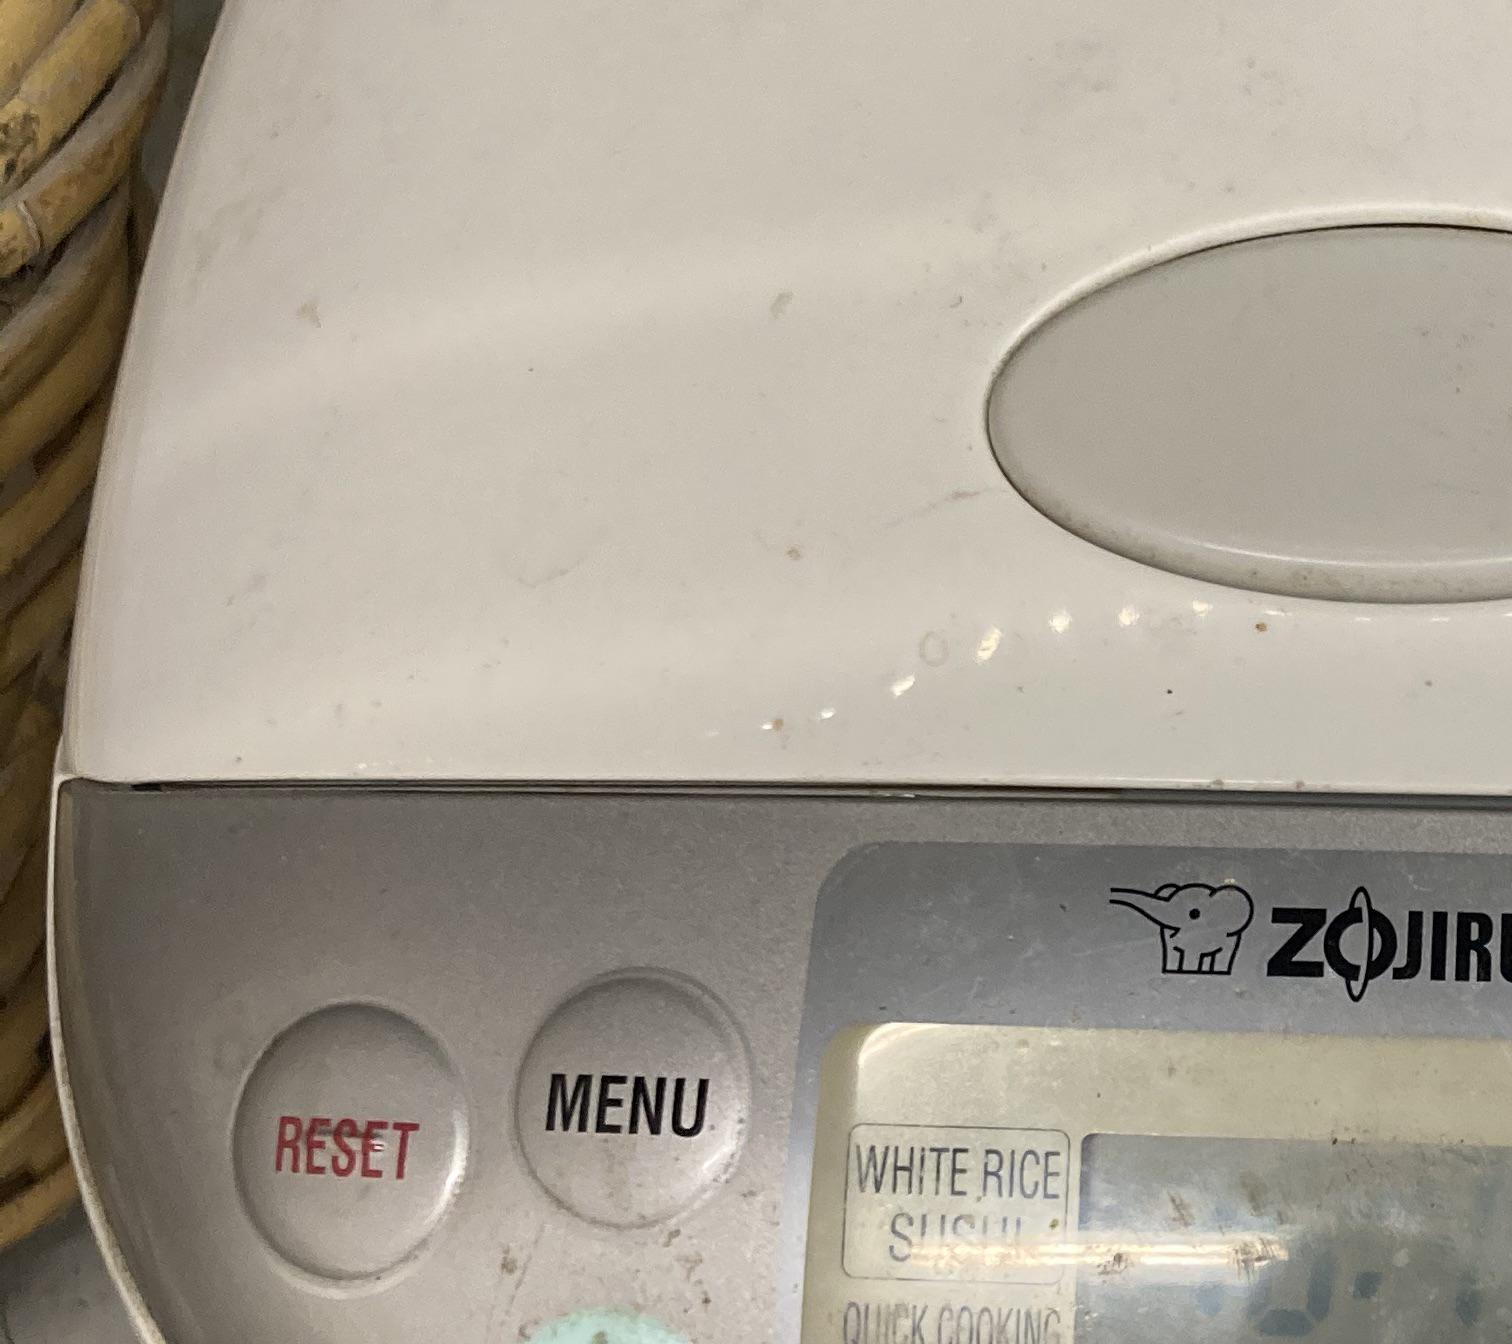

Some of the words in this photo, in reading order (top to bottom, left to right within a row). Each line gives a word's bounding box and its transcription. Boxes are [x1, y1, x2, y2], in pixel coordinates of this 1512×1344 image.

[545, 1073, 709, 1138] MENU
[275, 1116, 420, 1181] RESET
[856, 1145, 969, 1197] WHITE
[981, 1148, 1061, 1200] RICE
